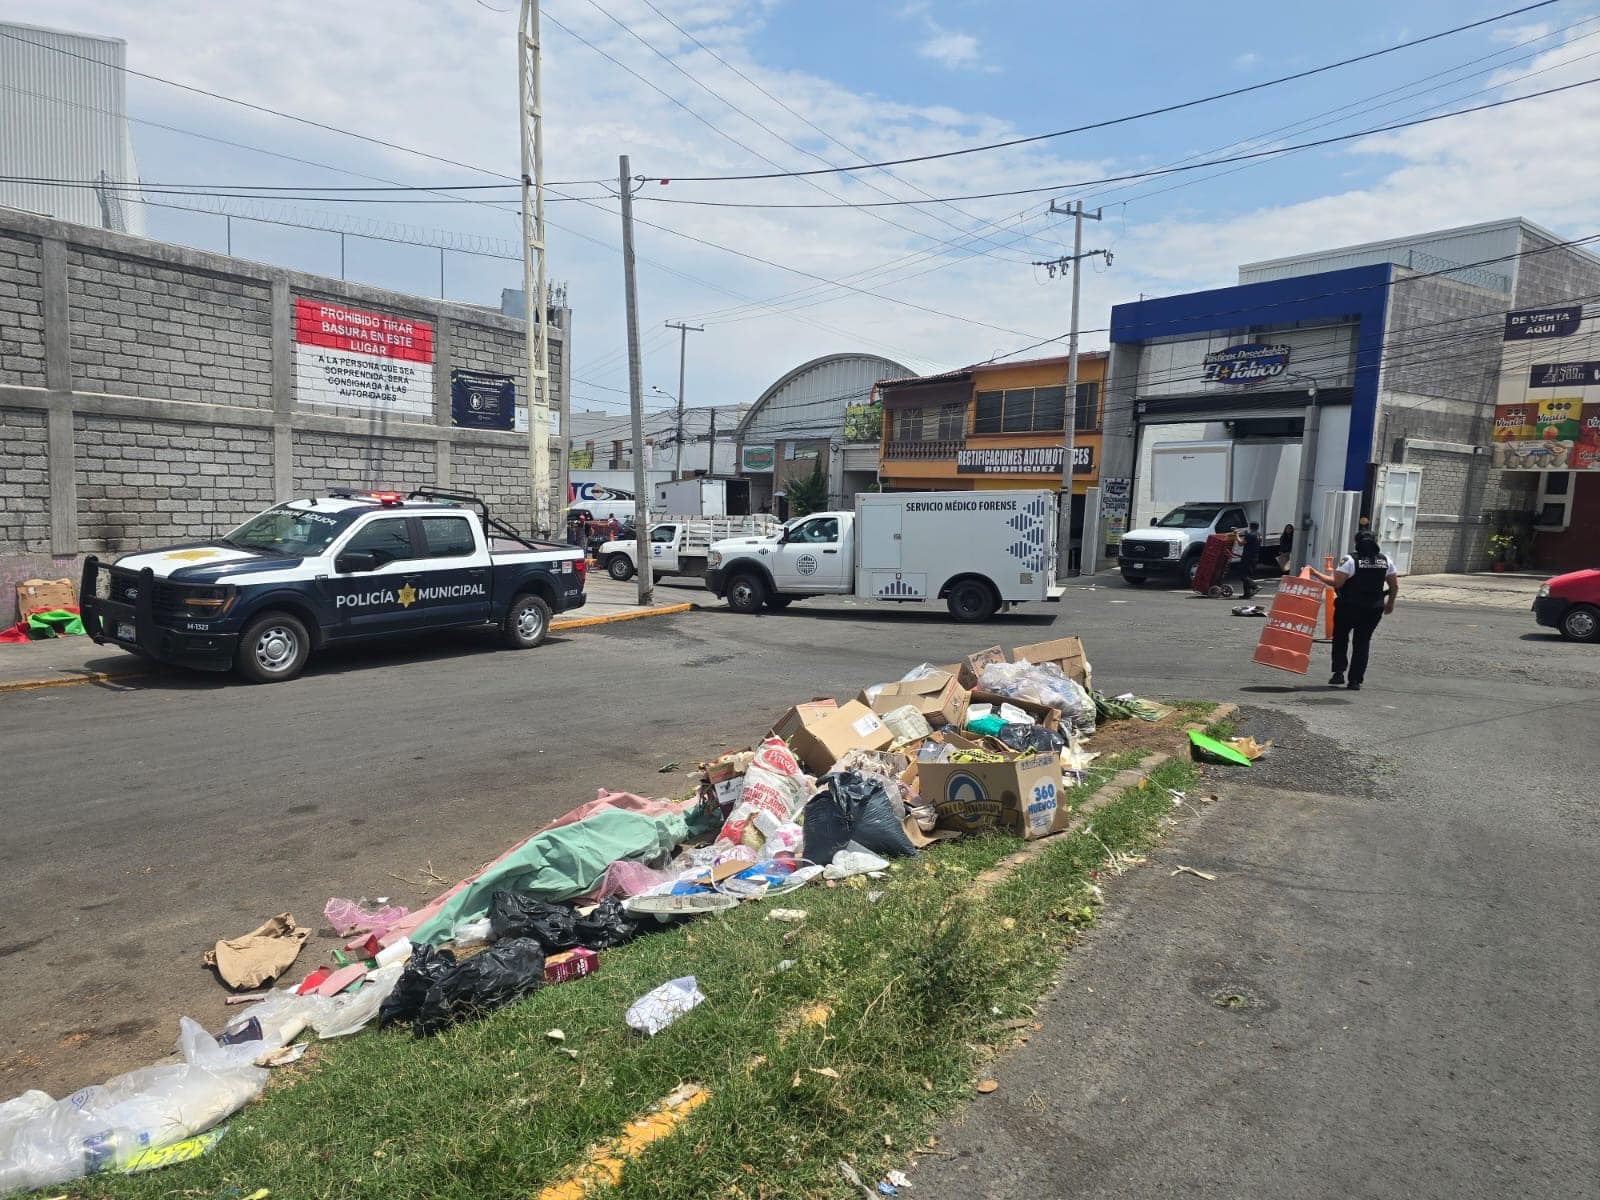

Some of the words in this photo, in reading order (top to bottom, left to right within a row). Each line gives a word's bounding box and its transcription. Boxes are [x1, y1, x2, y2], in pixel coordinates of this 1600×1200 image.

[320, 307, 380, 328] PROHIBIDO
[383, 319, 413, 334] TIRAR
[1511, 316, 1527, 325] DE
[1530, 312, 1571, 323] VENTA
[321, 321, 368, 340] BASURA
[370, 330, 384, 342] EN
[387, 333, 413, 347] ESTE
[350, 340, 386, 355] LUGAR
[318, 354, 325, 362] A
[326, 355, 338, 364] LA
[340, 357, 379, 370] PERSONA
[381, 363, 398, 374] QUE
[399, 366, 415, 376] SEA
[327, 376, 382, 391] CONSIGNADA
[384, 383, 391, 391] A
[391, 385, 407, 394] LAS
[340, 388, 397, 402] AUTORIDADES
[958, 449, 1023, 466] RECTIFICACIONES
[1023, 448, 1090, 465] AUTOMOTCES
[905, 502, 943, 512] SERVICIO
[944, 500, 977, 511] MÉDICO
[979, 500, 1017, 511] FORENSE
[336, 588, 395, 608] POLICÍA
[418, 583, 486, 601] MUNICIPAL
[1034, 783, 1055, 802] 360
[1027, 798, 1057, 815] HUEVOS
